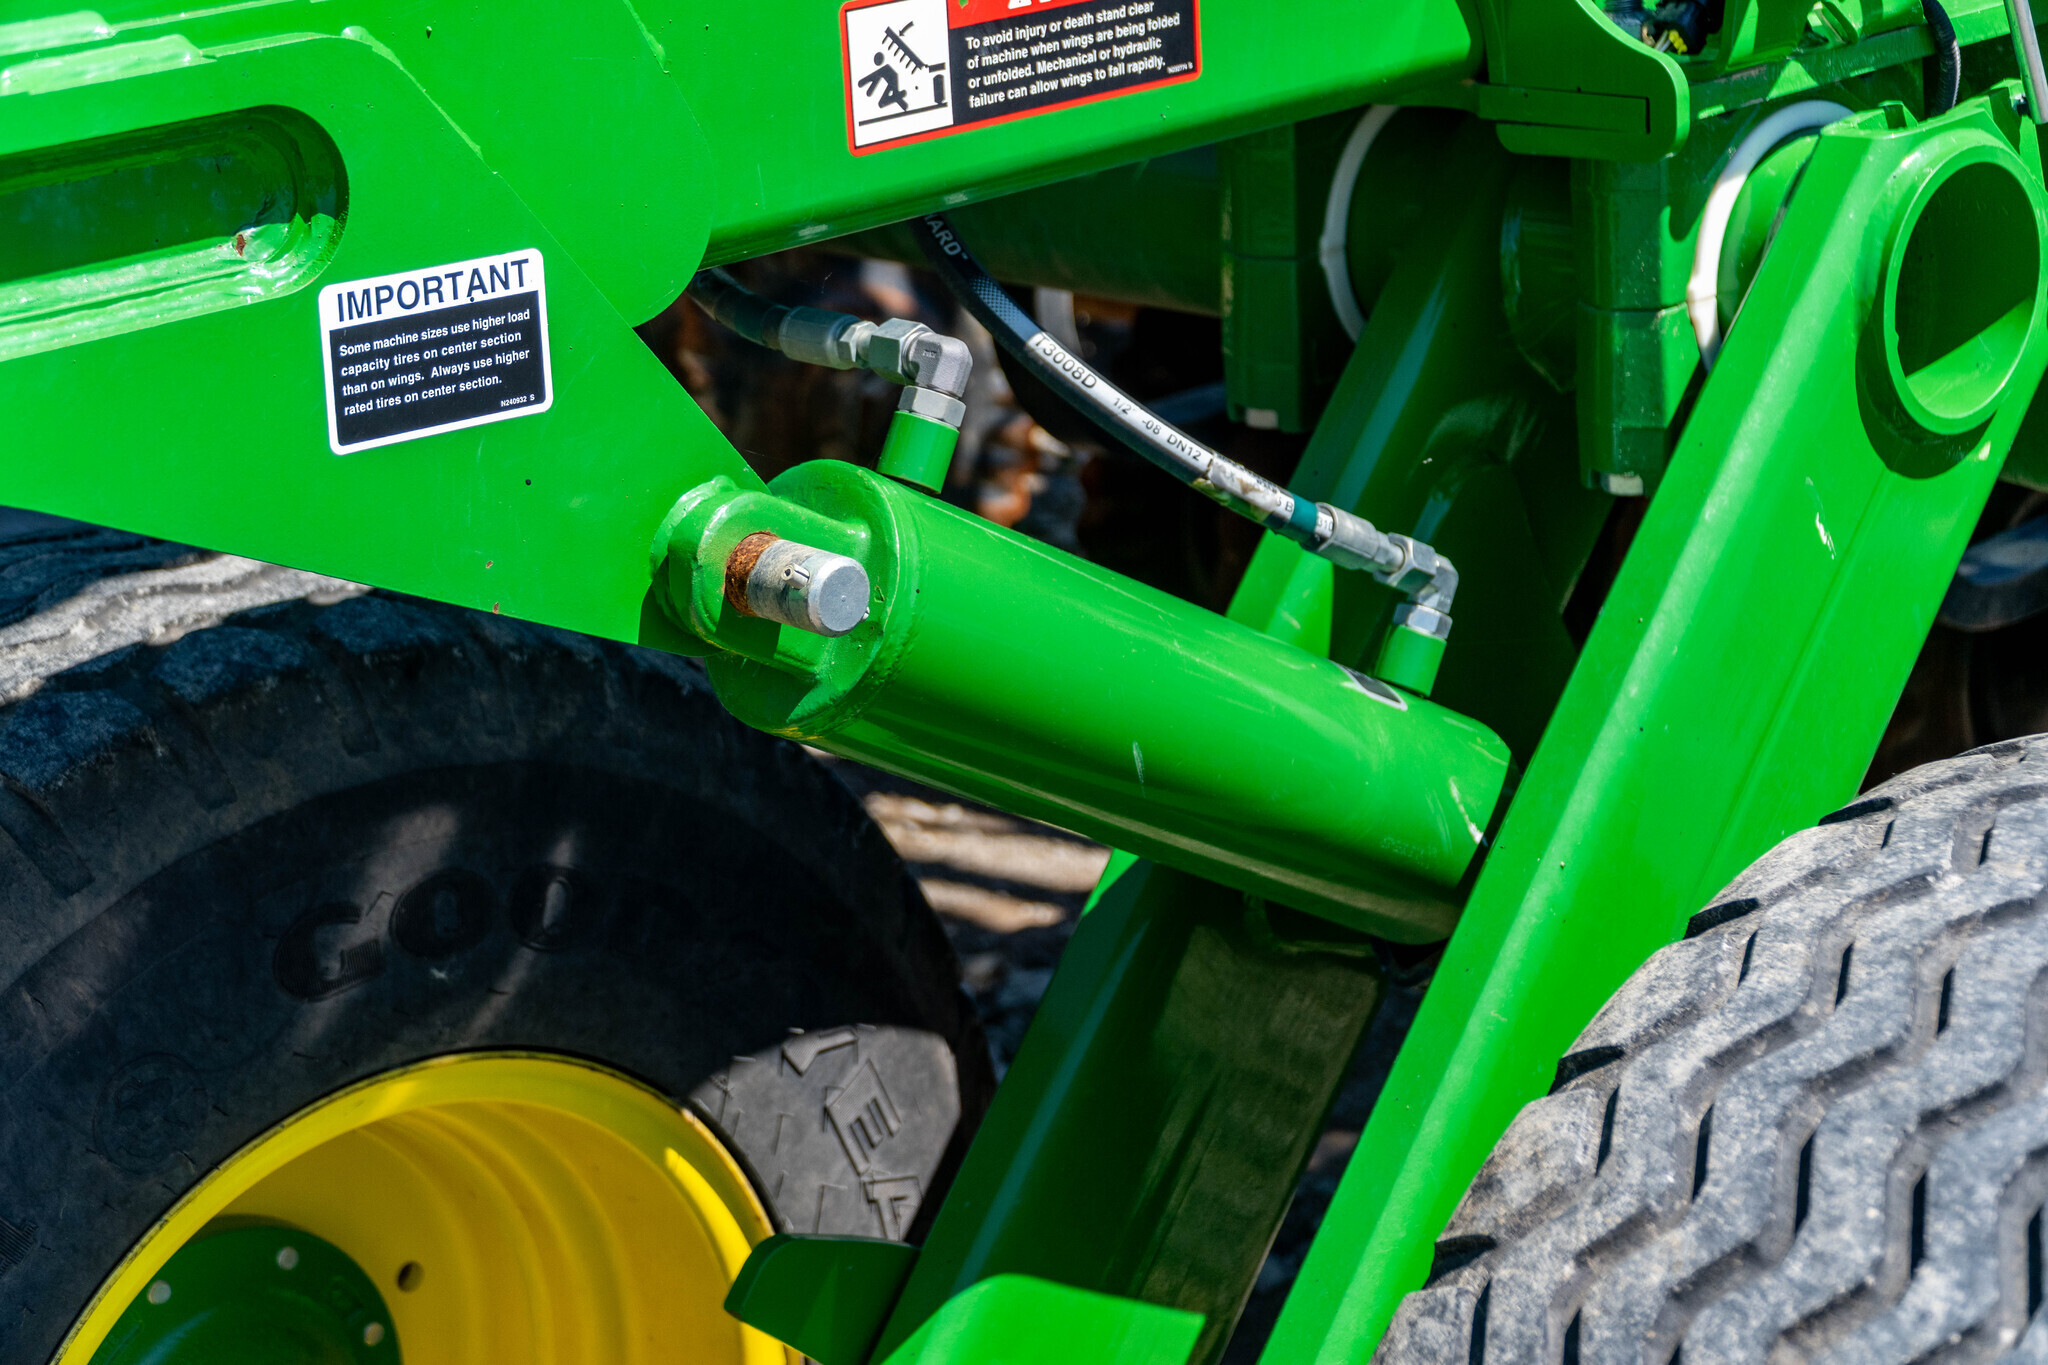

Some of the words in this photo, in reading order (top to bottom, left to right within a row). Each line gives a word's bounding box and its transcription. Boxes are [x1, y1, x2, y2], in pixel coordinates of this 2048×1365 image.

[965, 36, 980, 50] To
[982, 28, 1013, 47] avoid
[1015, 24, 1047, 41] injury
[1049, 21, 1061, 33] or
[1063, 12, 1095, 30] death
[1095, 4, 1126, 23] stand
[1127, 1, 1154, 16] clear
[966, 55, 980, 70] of
[981, 47, 1028, 67] machine
[1030, 40, 1060, 56] when
[1061, 33, 1094, 49] wings
[1095, 29, 1114, 42] are
[1115, 22, 1146, 38] being
[1146, 12, 1180, 32] folded
[967, 77, 981, 89] or
[982, 63, 1036, 86] unfolded.
[1036, 49, 1097, 75] Mechanical
[1098, 49, 1111, 61] or
[1112, 36, 1162, 60] hydraulic
[968, 91, 1006, 108] failure
[1006, 86, 1028, 100] can
[1029, 79, 1059, 96] allow
[1060, 71, 1093, 87] wings
[1093, 68, 1107, 81] to
[1107, 61, 1125, 78] fall
[1126, 55, 1166, 75] rapidly.
[337, 258, 529, 323] IMPORTANT
[339, 341, 371, 357] Some
[373, 331, 419, 351] machine
[421, 325, 449, 341] sizes
[451, 322, 470, 335] use
[472, 313, 506, 332] higher
[507, 309, 531, 324] load
[341, 355, 390, 377] capacity
[393, 350, 420, 366] tires
[423, 349, 438, 360] on
[441, 339, 477, 356] center
[480, 331, 522, 348] section
[342, 380, 368, 396] than
[371, 378, 386, 390] on
[388, 369, 425, 389] wings.
[430, 360, 471, 379] Always
[473, 357, 493, 370] use
[495, 348, 530, 367] higher
[344, 399, 374, 416] rated
[376, 393, 402, 409] tires
[404, 391, 419, 403] on
[421, 382, 456, 400] center
[459, 376, 503, 392] section.
[500, 395, 528, 407] N240932
[1034, 336, 1097, 389] T3008D
[1142, 418, 1162, 435] -08
[1166, 433, 1202, 462] DN12
